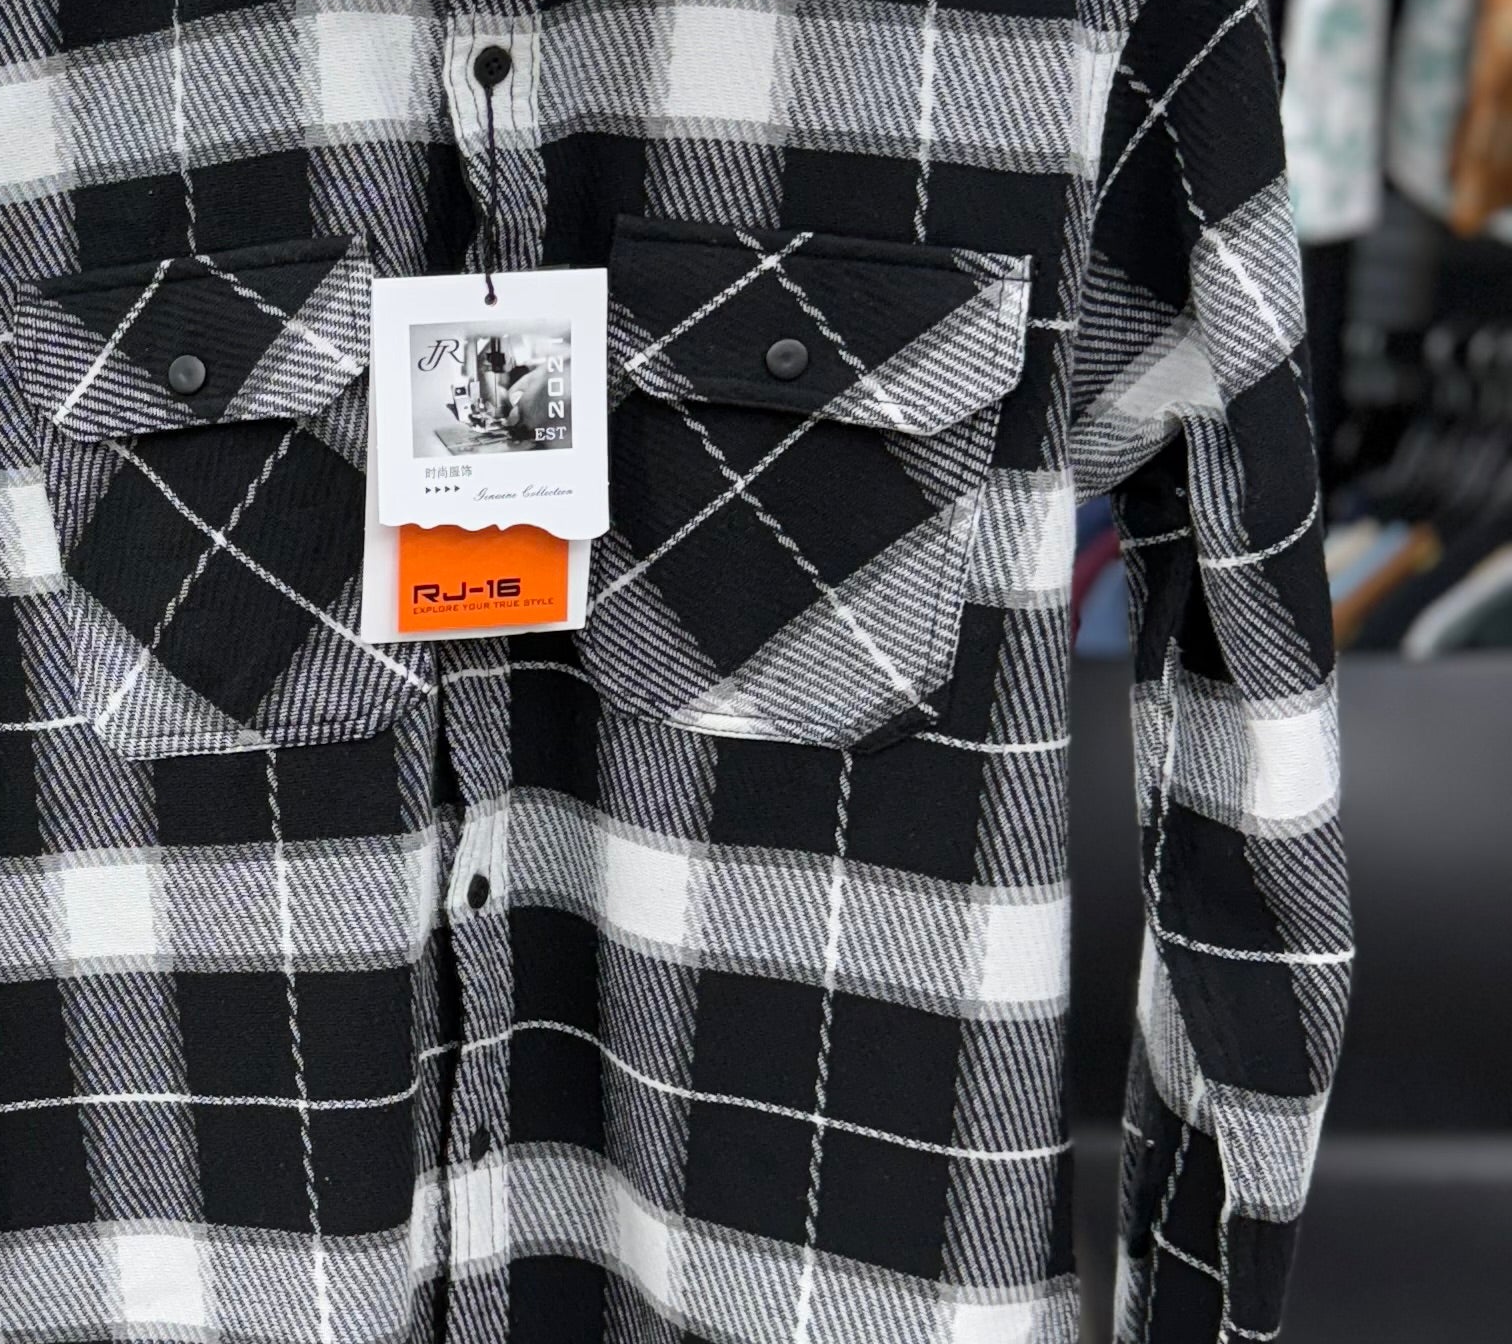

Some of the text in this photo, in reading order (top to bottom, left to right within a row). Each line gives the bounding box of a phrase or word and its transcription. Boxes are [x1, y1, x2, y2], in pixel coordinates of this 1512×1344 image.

[548, 338, 565, 419] 2021
[534, 426, 567, 442] EST
[522, 484, 574, 498] Collection
[413, 578, 521, 604] RJ-16
[413, 597, 554, 615] EXPLORE YOUR TRUE STYLE
